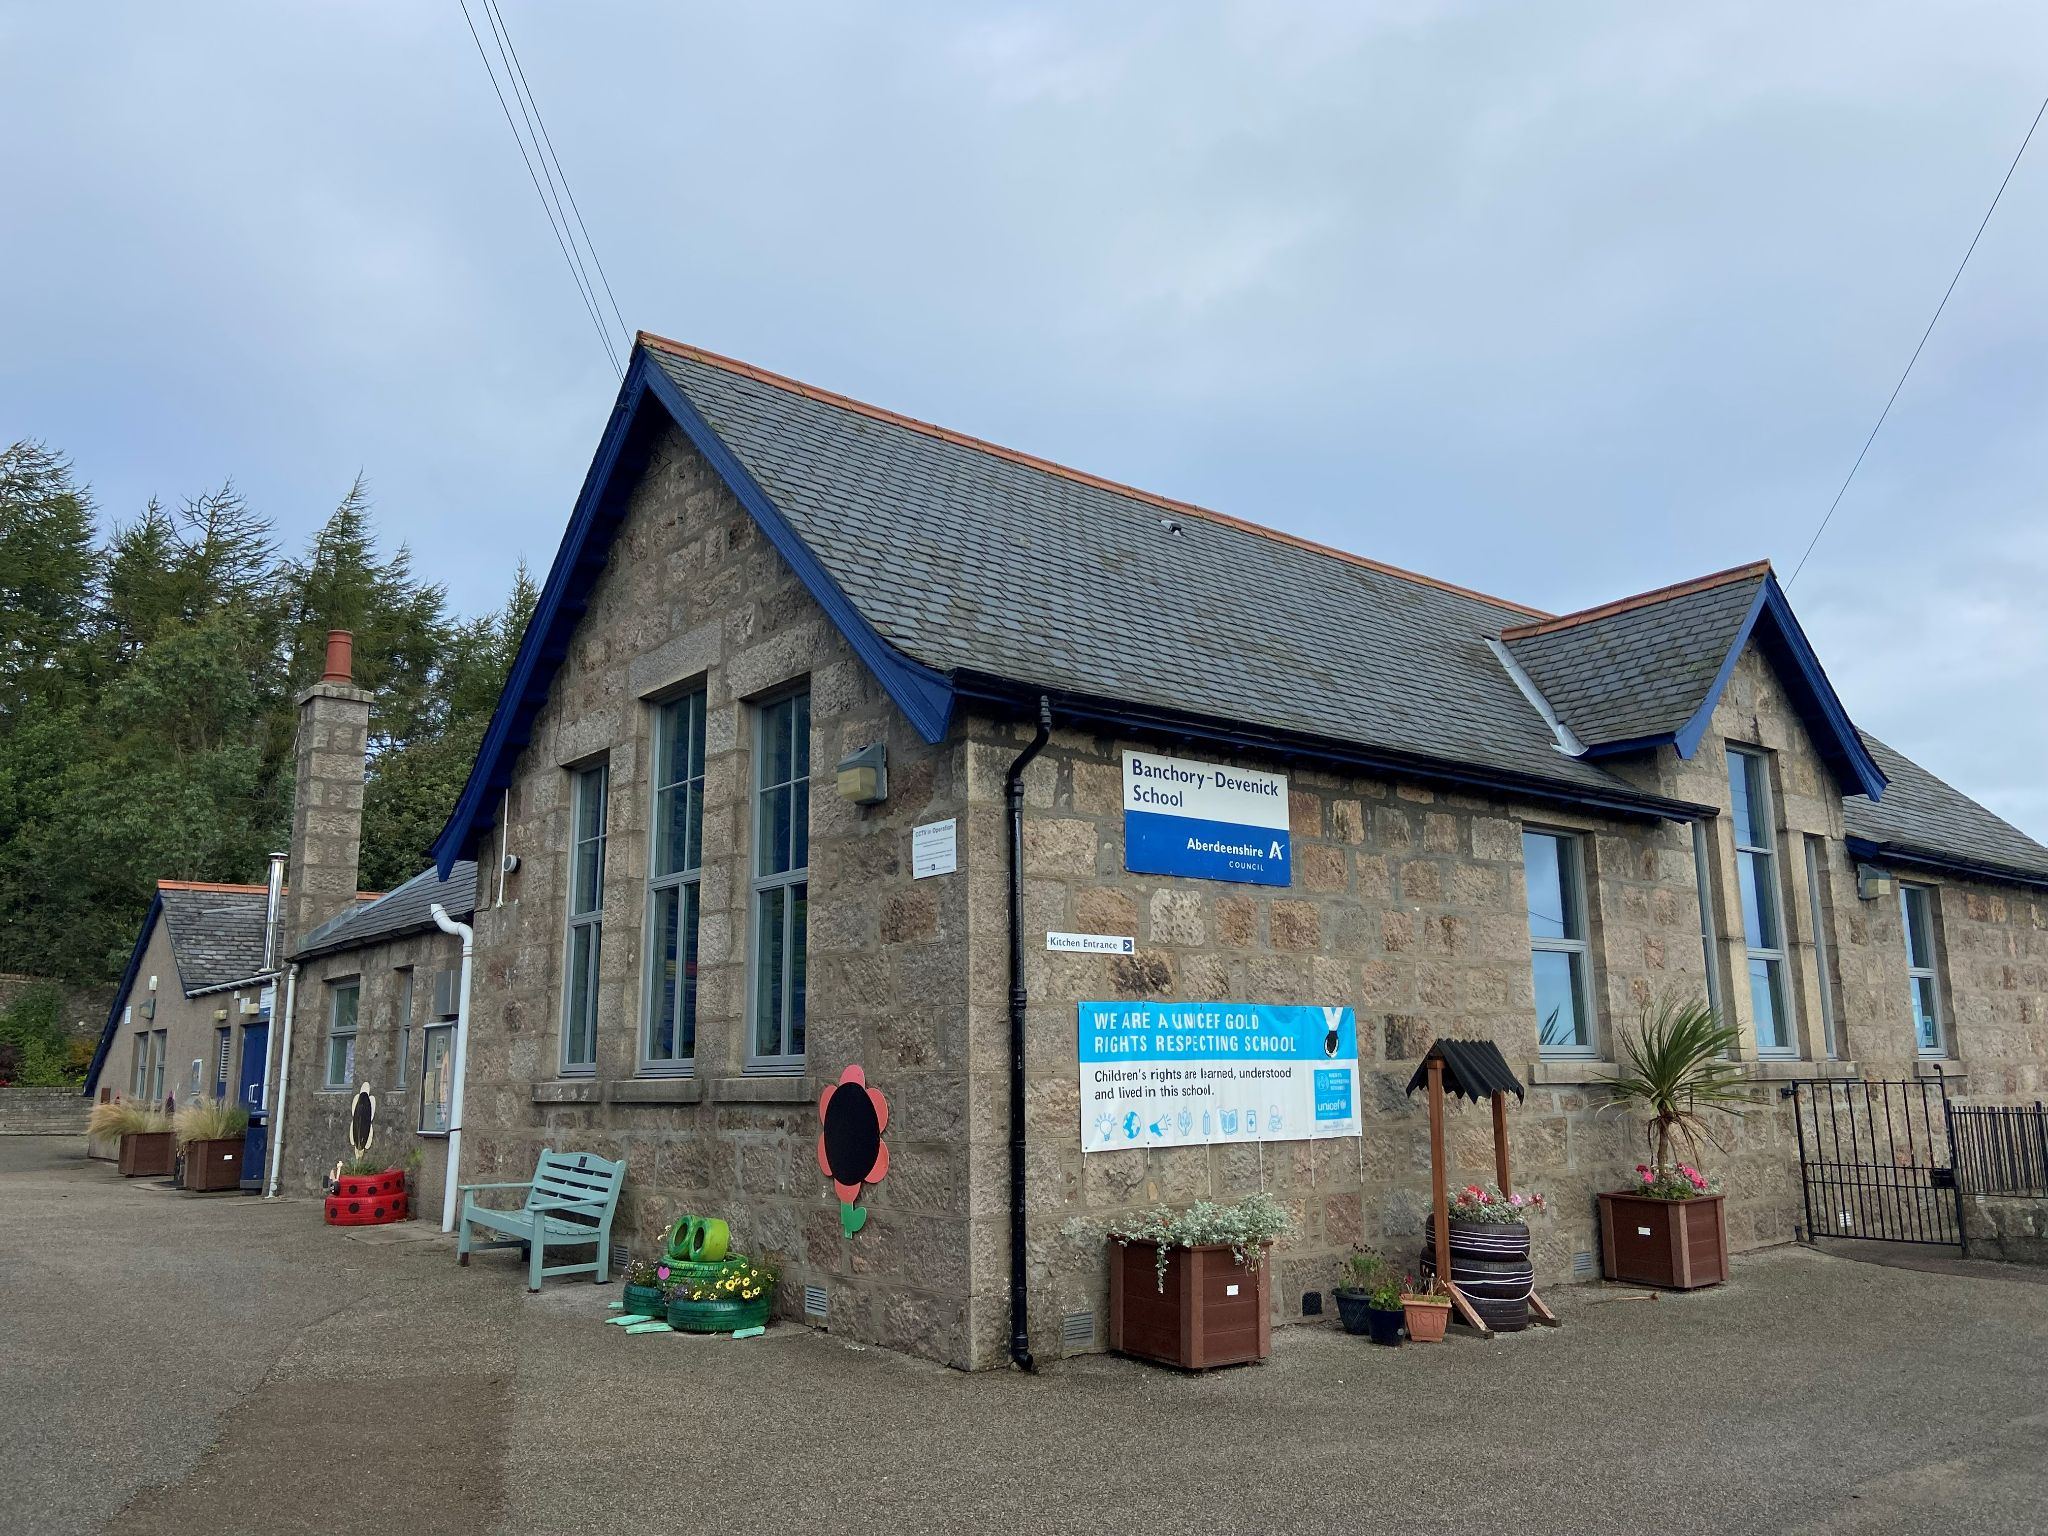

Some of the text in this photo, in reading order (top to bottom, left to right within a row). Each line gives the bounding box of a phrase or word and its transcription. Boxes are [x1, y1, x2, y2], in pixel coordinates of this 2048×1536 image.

[1132, 758, 1279, 797] Banchory-Devenick
[1133, 784, 1184, 808] School
[932, 825, 954, 834] Operation
[1186, 837, 1264, 858] Aberdeenshire
[1229, 860, 1265, 872] COUNCIL
[1050, 937, 1118, 950] Kitchen Entrance
[1094, 1012, 1259, 1030] WE ARE A UNICEF GOLD
[1094, 1035, 1297, 1054] RIGHTS RESPECTING SCHOOL
[1094, 1067, 1292, 1083] Children's rights are learned, understood
[1094, 1084, 1215, 1100] and lived in this school.
[1317, 1099, 1340, 1111] unicef
